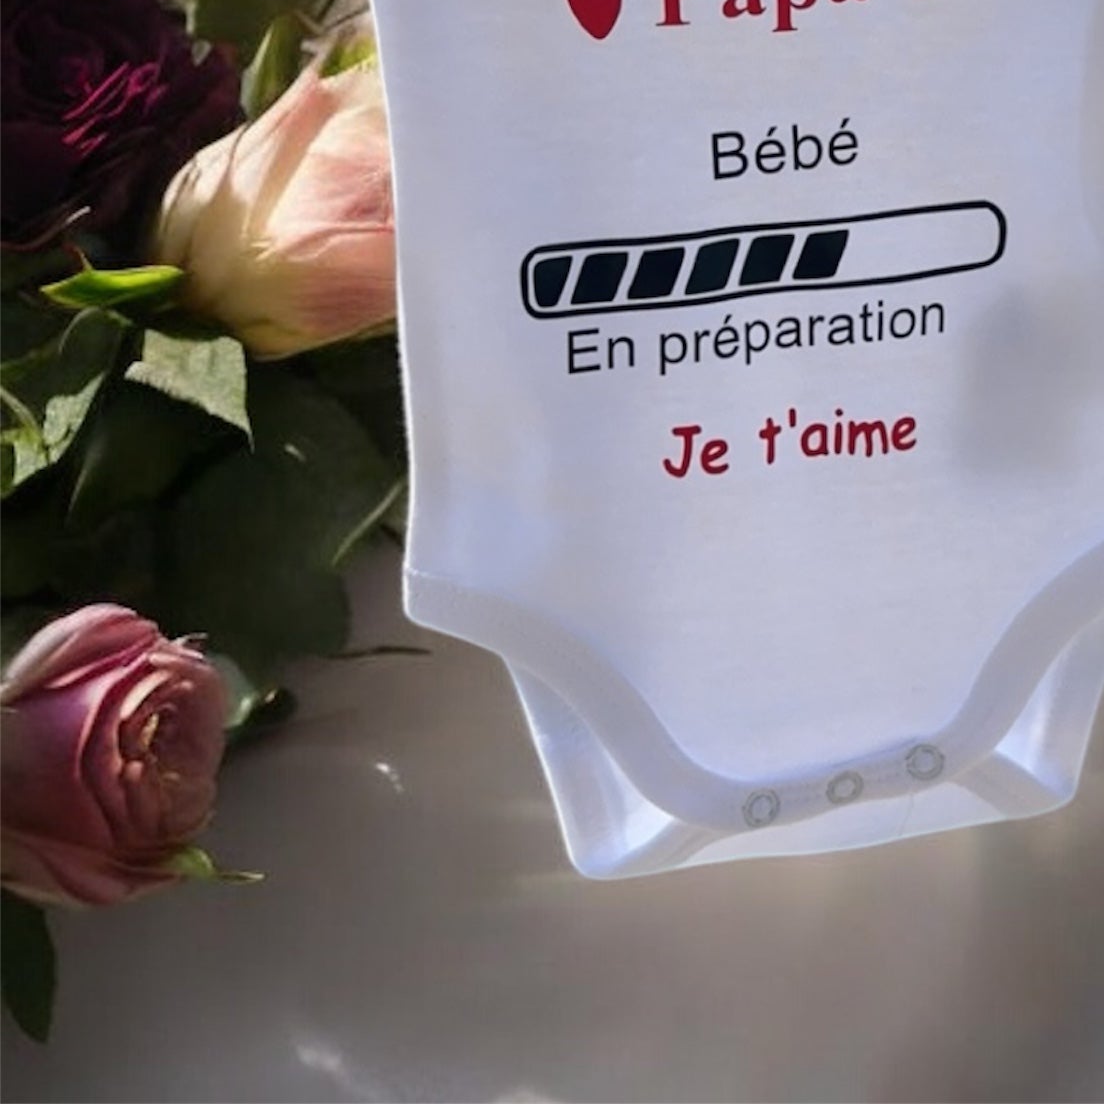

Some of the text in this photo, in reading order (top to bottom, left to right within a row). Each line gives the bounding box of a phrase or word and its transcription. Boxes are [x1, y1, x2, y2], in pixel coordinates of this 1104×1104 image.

[711, 116, 859, 181] Bébé
[567, 299, 945, 377] En préparation
[662, 407, 918, 479] Je t'aime
